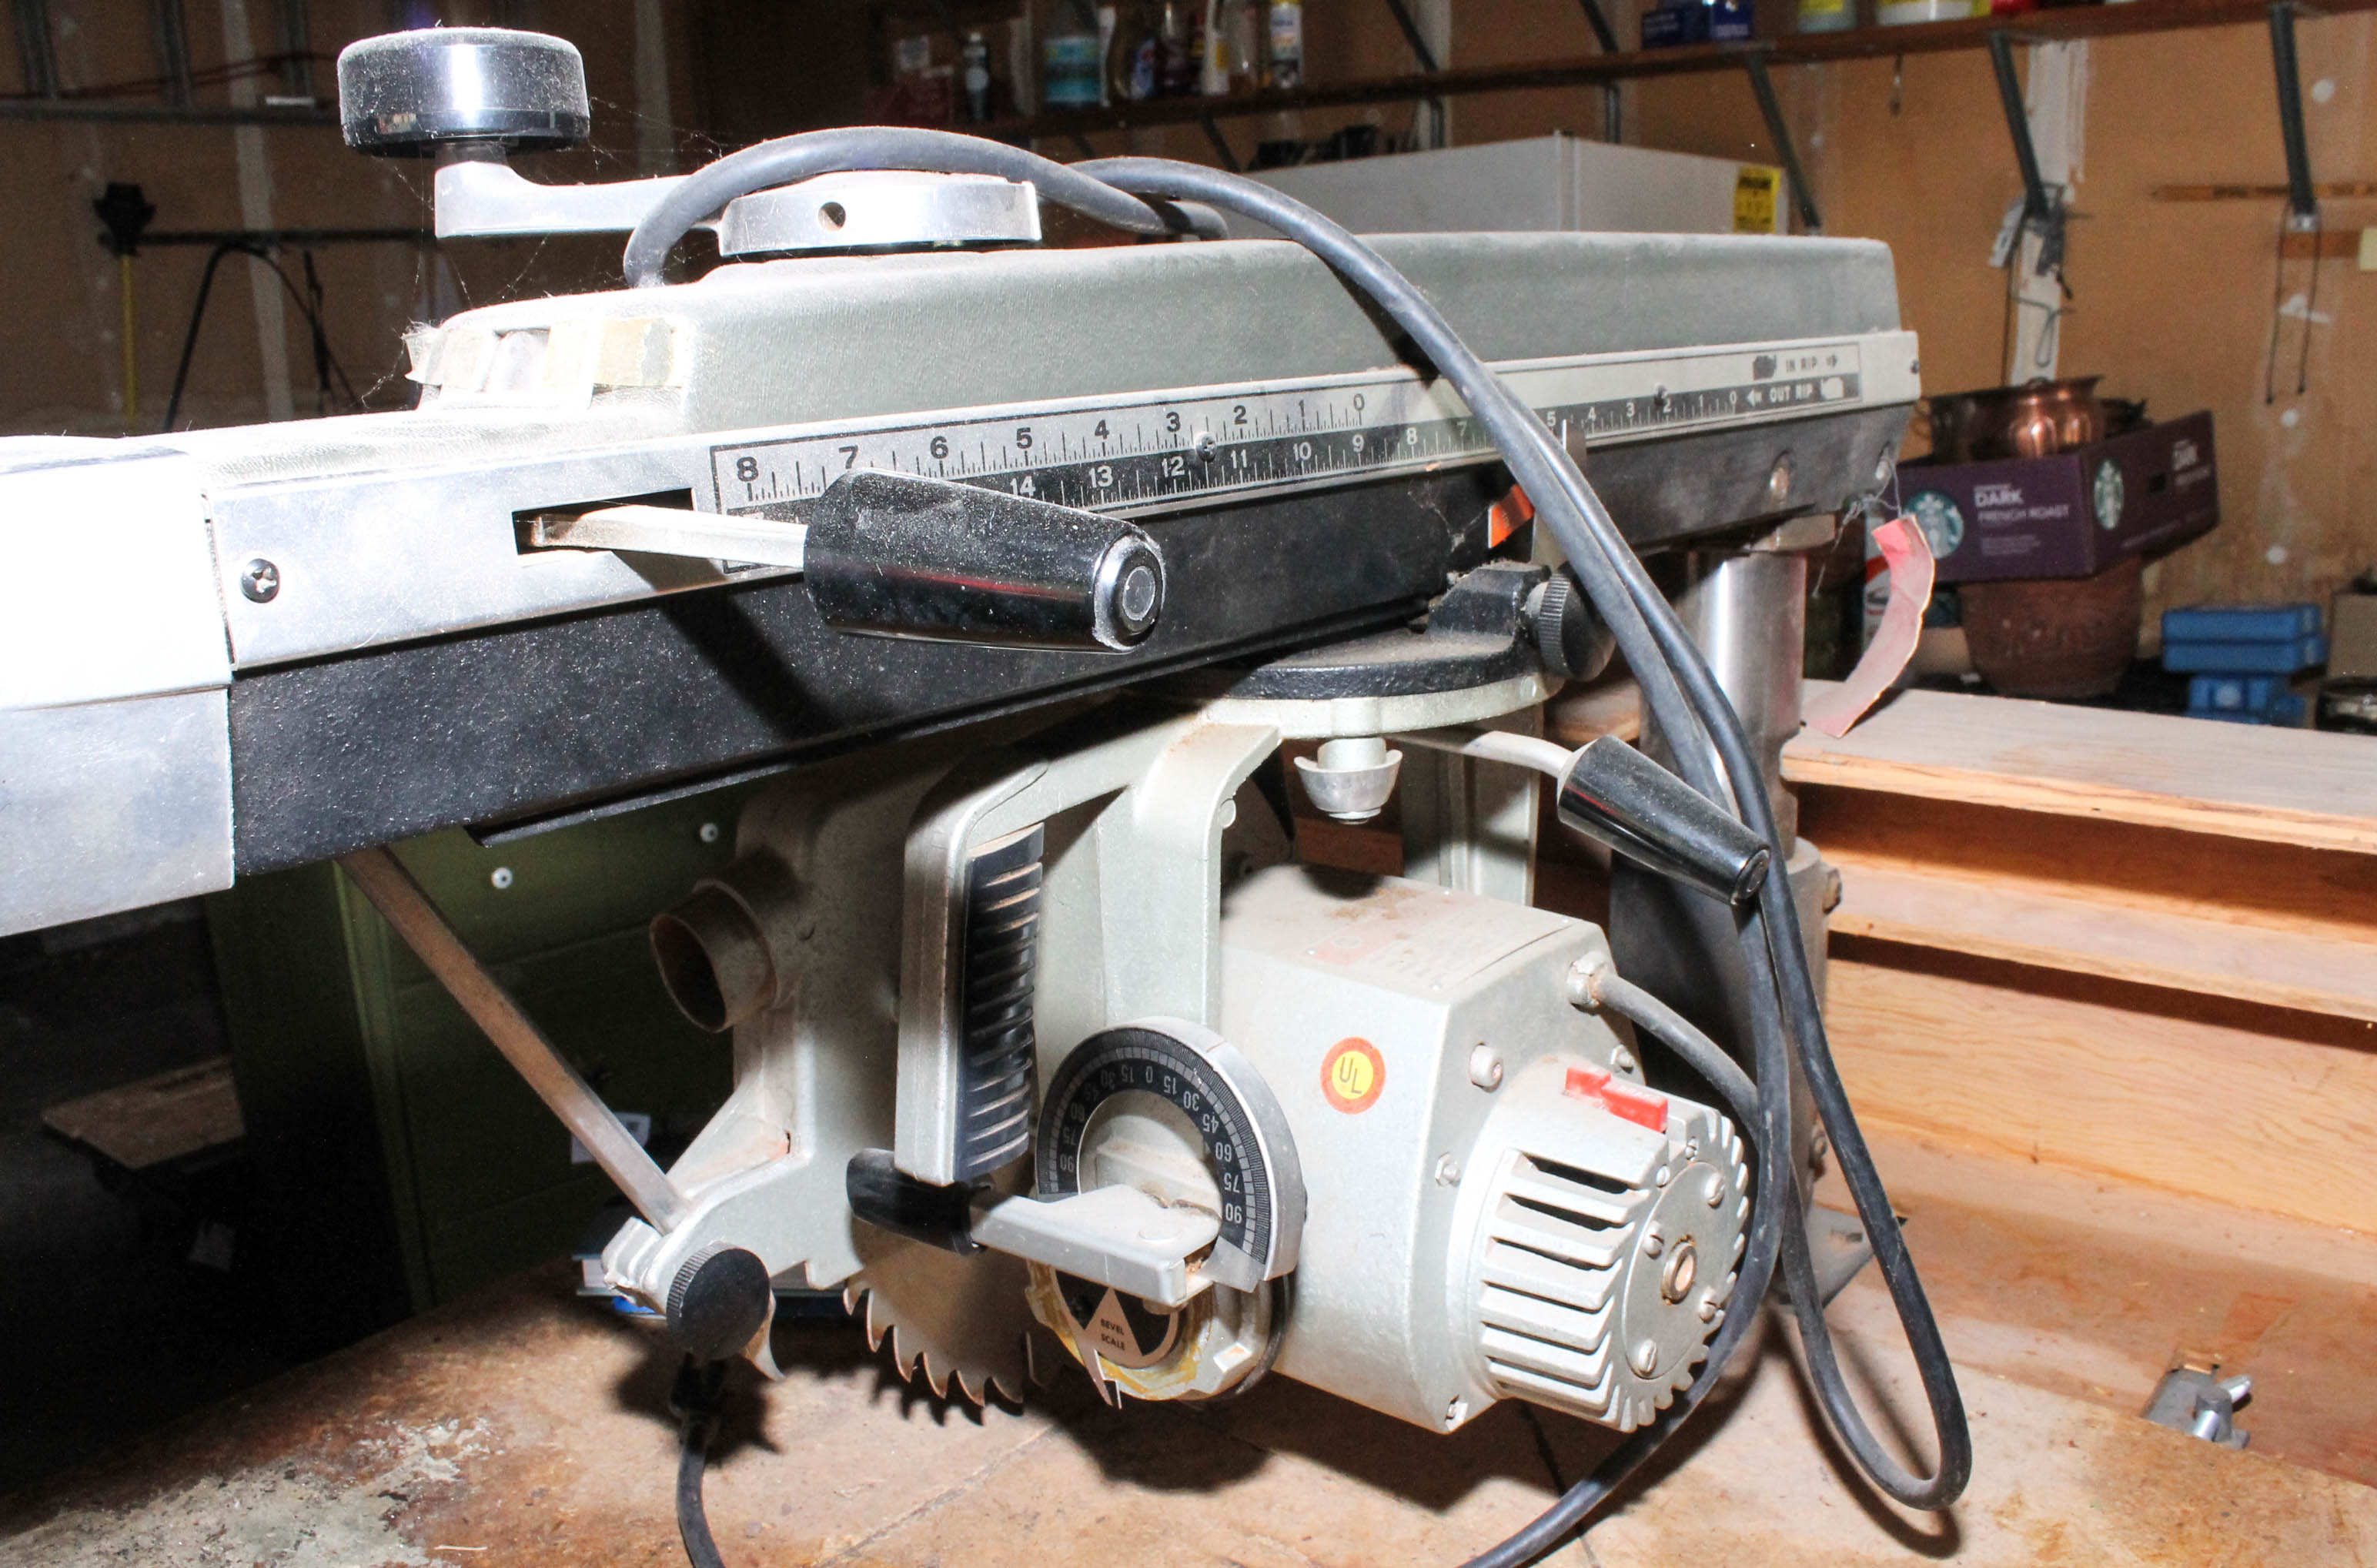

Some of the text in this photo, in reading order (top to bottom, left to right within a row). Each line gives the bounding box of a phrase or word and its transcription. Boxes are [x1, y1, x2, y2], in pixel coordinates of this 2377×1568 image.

[1769, 386, 1791, 403] OUT
[736, 393, 1366, 483] 8 7 6 5 4 3 2 1 0
[1009, 390, 1738, 497] 14 13 12 11 10 9 8 7 5 4 3 2 1 0
[1974, 488, 2024, 507] DARK
[1120, 1064, 1135, 1084] 15
[1145, 1065, 1154, 1085] 0
[1162, 1075, 1178, 1096] 15
[1182, 1090, 1200, 1112] 30
[1202, 1113, 1219, 1135] 45
[1215, 1141, 1233, 1162] 60
[1059, 1153, 1075, 1172] 90
[1223, 1172, 1241, 1194] 75
[1225, 1202, 1243, 1225] 90
[1099, 1317, 1125, 1336] BEVEL
[1100, 1334, 1126, 1352] SCALE
